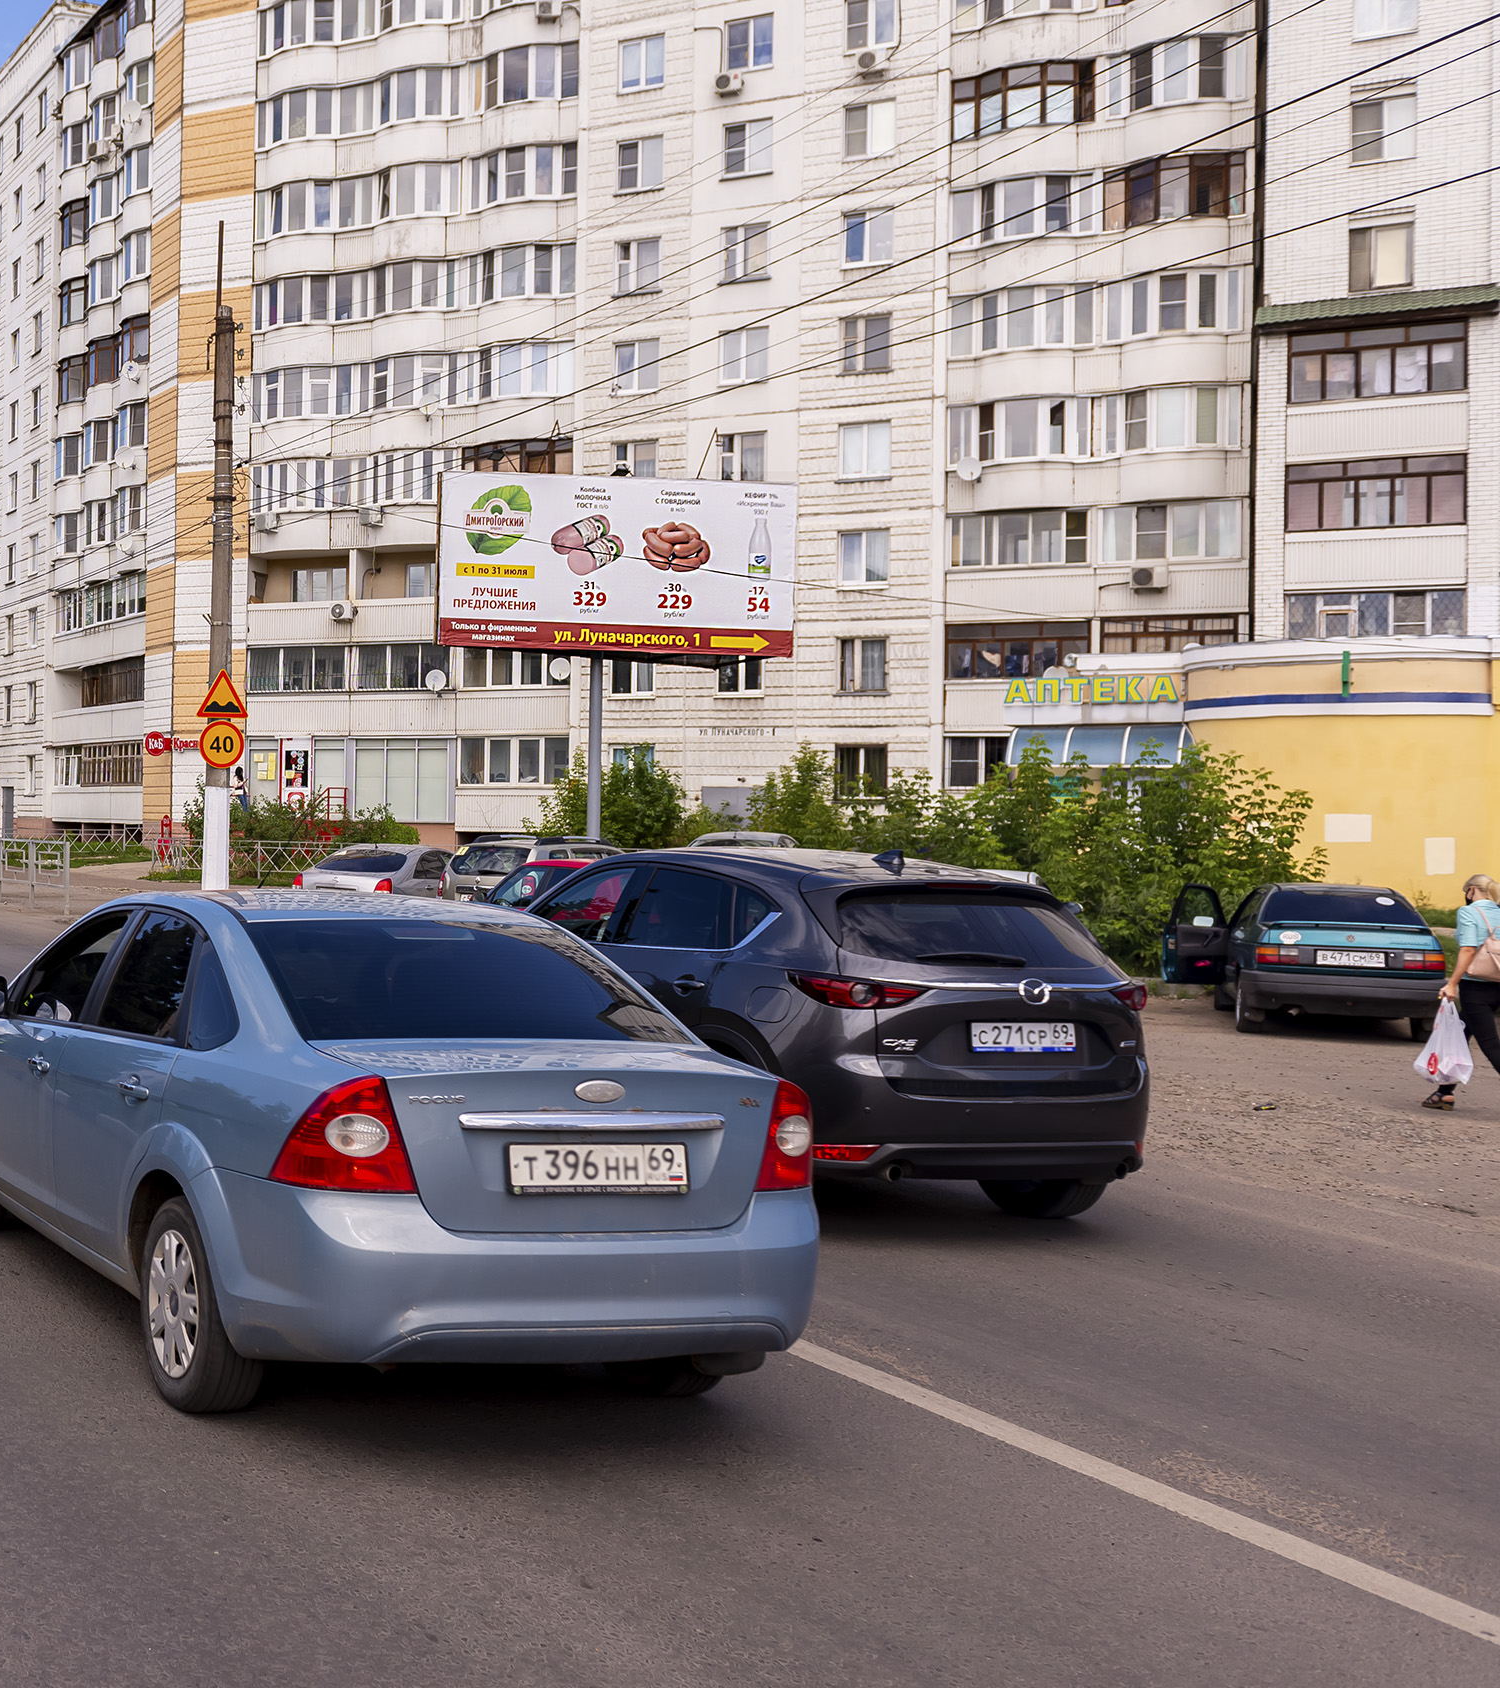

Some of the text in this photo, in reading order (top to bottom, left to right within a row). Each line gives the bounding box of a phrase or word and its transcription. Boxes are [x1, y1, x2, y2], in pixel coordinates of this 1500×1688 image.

[491, 566, 501, 574] 31
[503, 568, 528, 576] июля
[471, 587, 518, 598] ЛУЧШИЕ
[452, 598, 536, 611] ПРЕДЛОЖЕНИЯ
[572, 591, 607, 607] 329
[657, 593, 693, 610] 229
[746, 597, 771, 613] 54
[450, 621, 479, 630] Только
[487, 623, 537, 633] фирменных
[471, 633, 515, 642] магазинах
[553, 628, 700, 648] ул. Луначарского, 1
[1003, 675, 1179, 704] АПТЕКА
[699, 728, 708, 736] УЛ
[711, 727, 765, 736] ЛУНАЧАРСКОГО
[148, 738, 164, 750] К&Б
[209, 735, 234, 754] 40
[1369, 953, 1381, 961] 69
[1052, 1024, 1069, 1040] 69
[408, 1094, 466, 1105] FOCUS
[647, 1148, 675, 1171] 69
[647, 1173, 668, 1181] RUS
